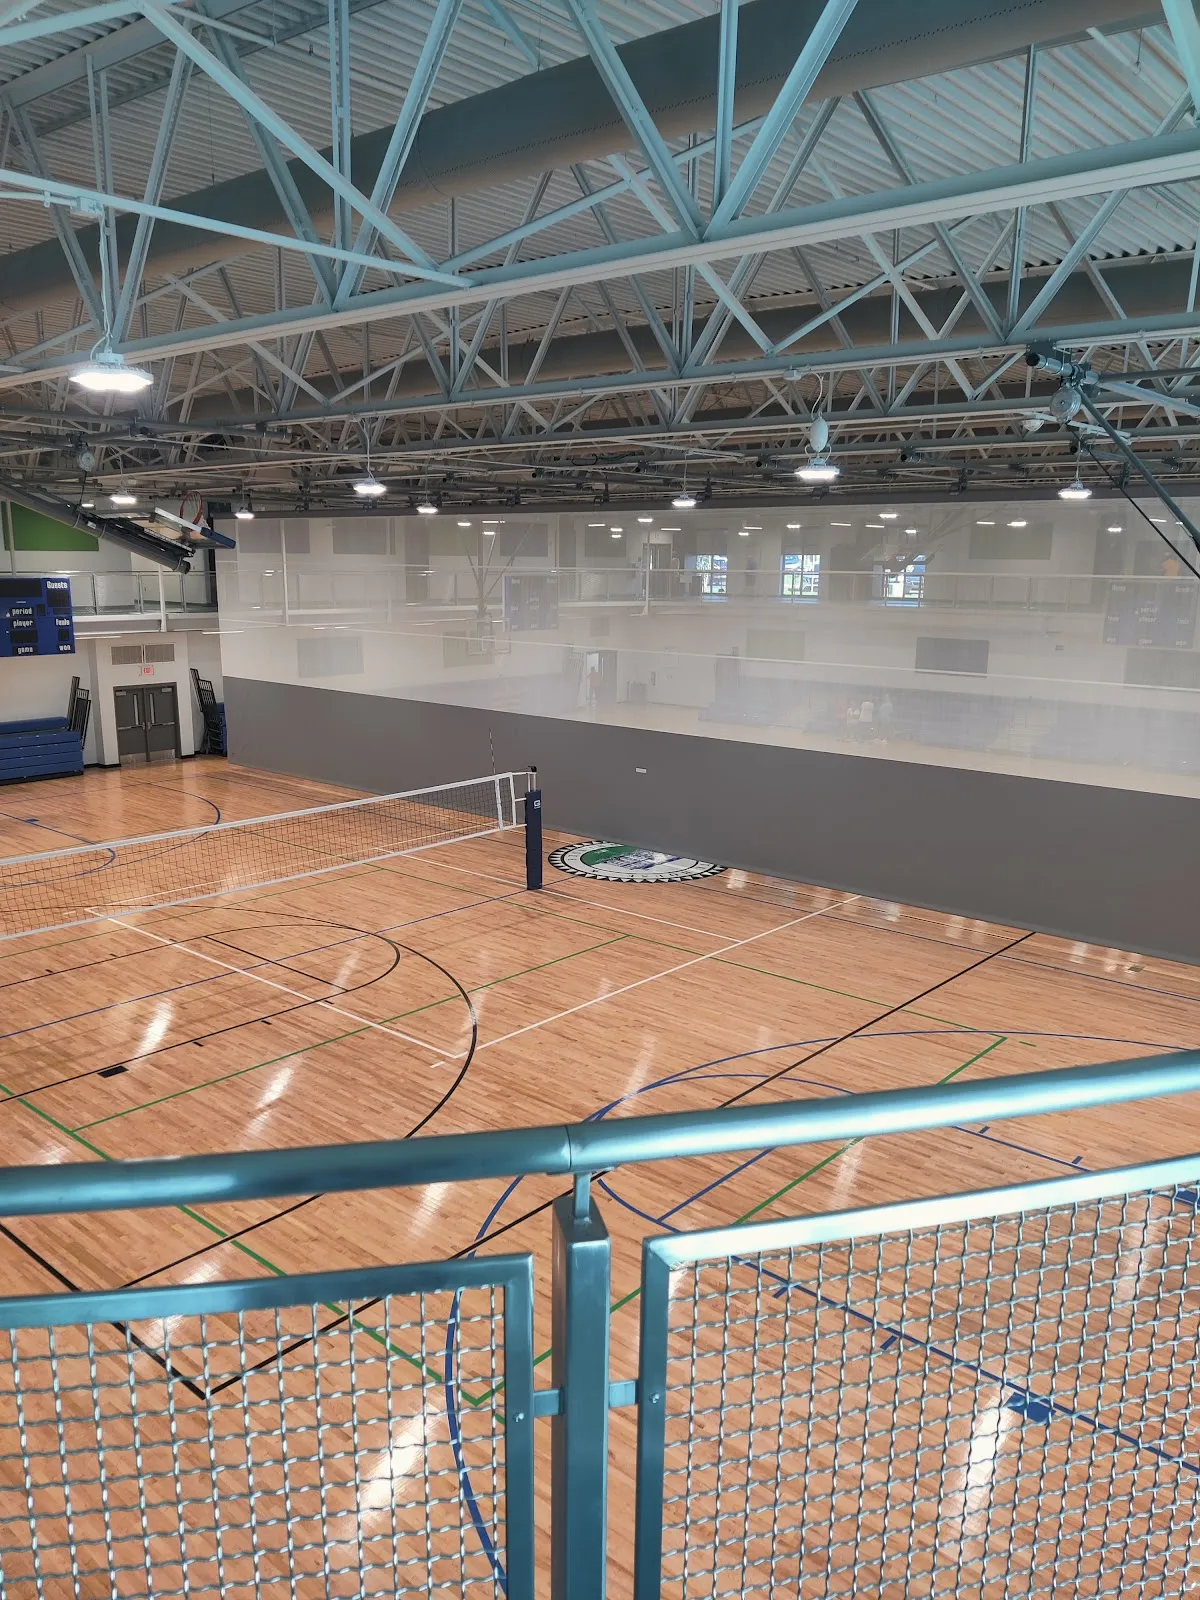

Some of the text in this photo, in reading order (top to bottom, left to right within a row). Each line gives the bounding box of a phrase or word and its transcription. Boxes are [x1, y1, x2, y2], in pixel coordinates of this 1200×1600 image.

[46, 580, 68, 589] Guests
[12, 607, 33, 616] period
[13, 619, 33, 628] player
